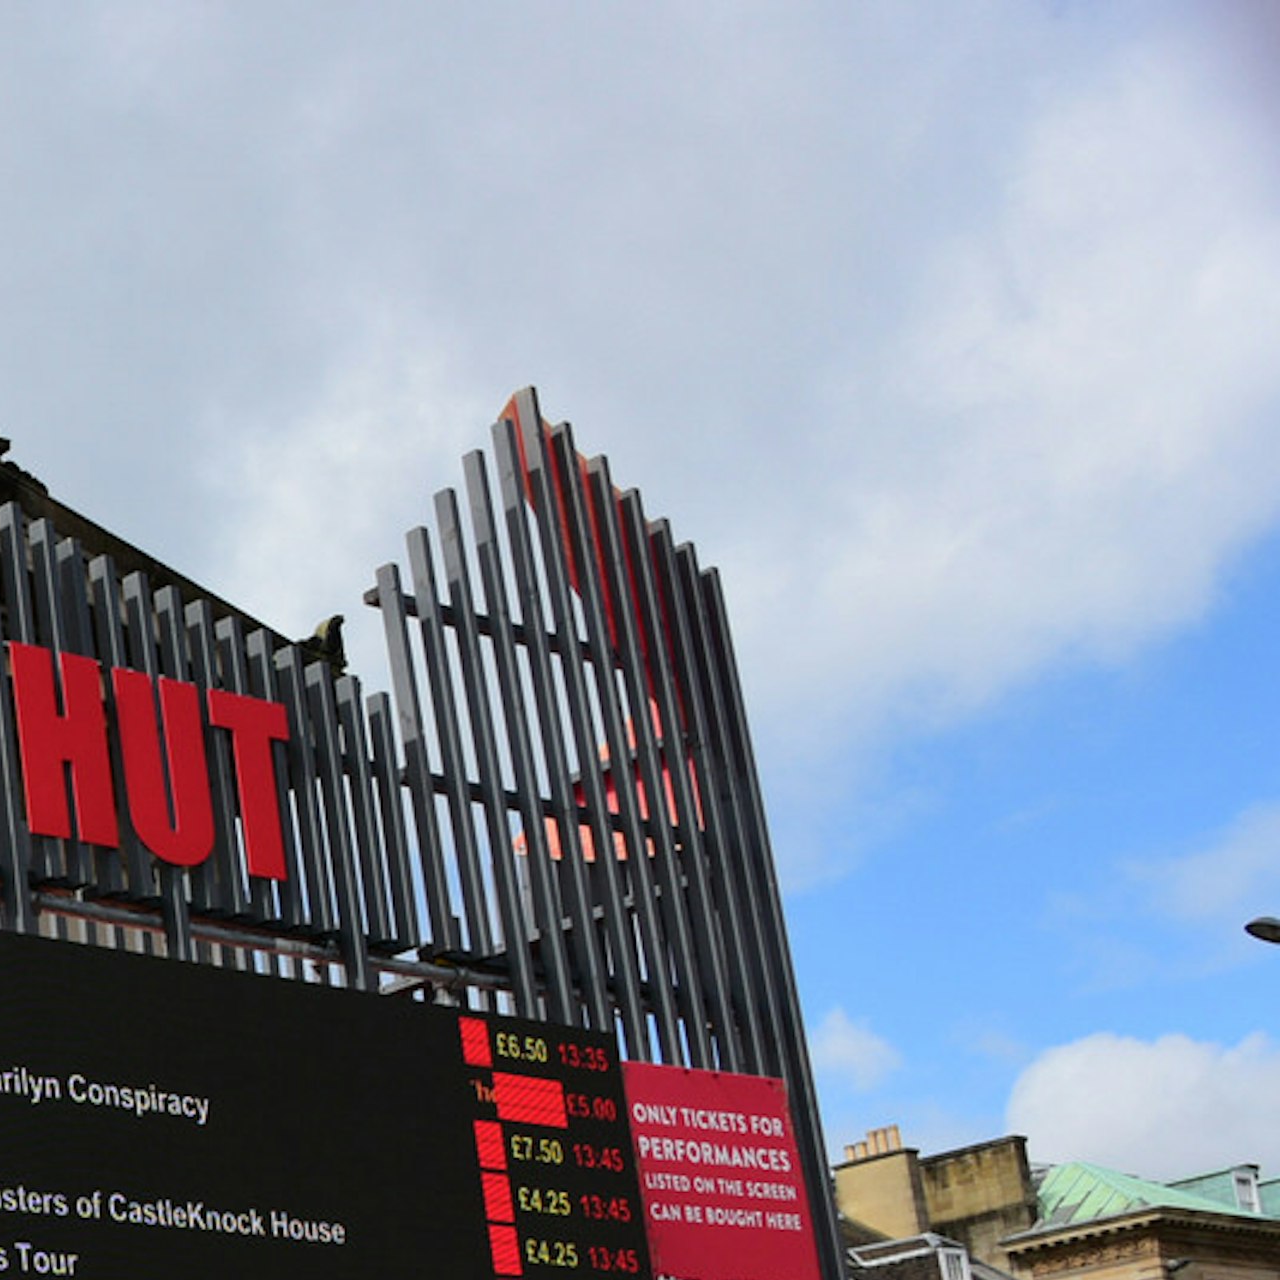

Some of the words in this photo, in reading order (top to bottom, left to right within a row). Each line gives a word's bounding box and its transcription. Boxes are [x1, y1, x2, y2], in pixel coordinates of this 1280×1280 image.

[8, 641, 290, 881] HUT
[497, 1033, 547, 1062] £6.50
[558, 1044, 608, 1071] 13:35
[68, 1075, 208, 1124] Conspiracy
[633, 1103, 676, 1125] ONLY
[680, 1108, 747, 1133] TICKETS
[750, 1116, 784, 1136] FOR
[511, 1135, 563, 1163] £7.50
[573, 1144, 623, 1172] 13:45
[639, 1136, 791, 1172] PERFORMANCES
[645, 1173, 690, 1191] LISTED
[694, 1177, 714, 1193] ON
[718, 1179, 743, 1196] THE
[746, 1181, 796, 1200] SCREEN
[77, 1191, 100, 1218] of
[109, 1193, 265, 1235] CastleKnock
[271, 1211, 345, 1244] House
[518, 1187, 570, 1215] £4.25
[581, 1195, 631, 1222] 13:45
[651, 1203, 681, 1220] CAN
[685, 1206, 702, 1222] BE
[706, 1207, 762, 1227] BOUGHT
[766, 1213, 801, 1230] HERE
[15, 1243, 77, 1275] Tour
[526, 1239, 578, 1267] £4.25
[589, 1247, 639, 1273] 13:45
